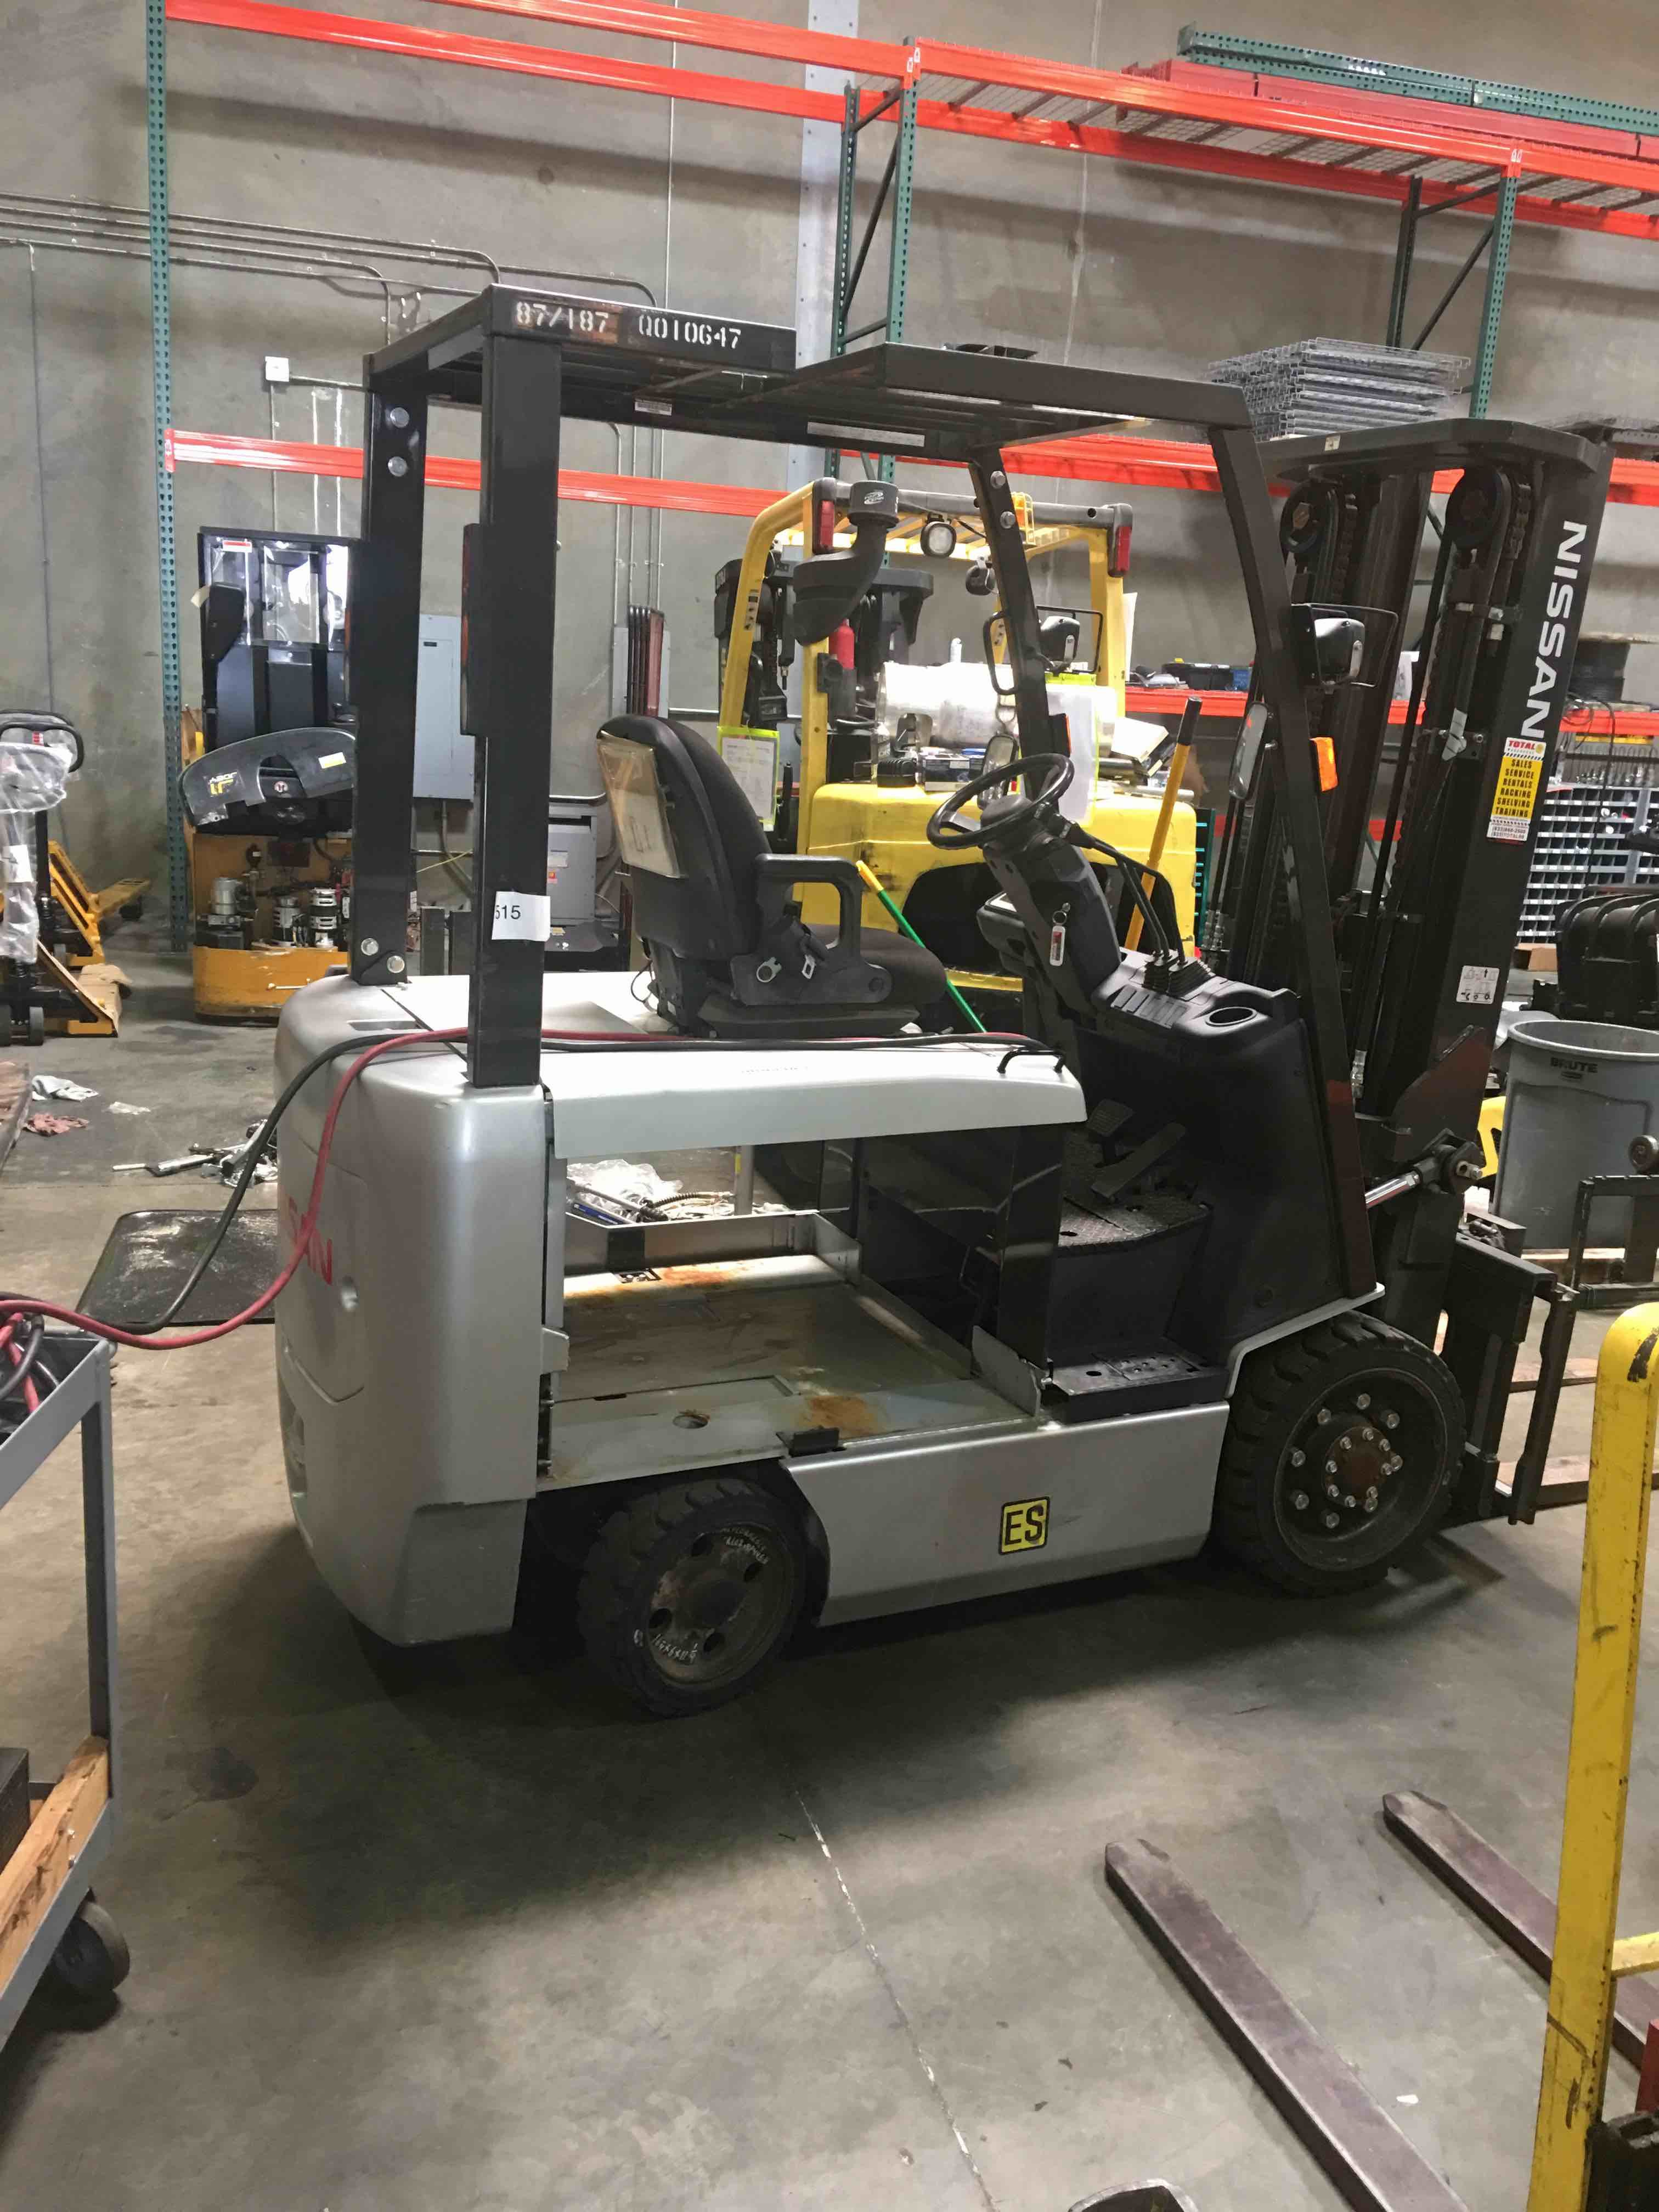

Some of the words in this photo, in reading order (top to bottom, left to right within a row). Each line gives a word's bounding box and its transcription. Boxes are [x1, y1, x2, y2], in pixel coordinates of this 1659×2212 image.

[1521, 521, 1587, 738] NISSAN
[1509, 741, 1536, 750] TOTAL
[1511, 759, 1532, 769] SALES
[1505, 769, 1534, 779] SERVICE
[1503, 778, 1533, 789] RENTALS
[1500, 788, 1531, 799] RACKING
[1497, 797, 1530, 808] SHELVING
[1496, 807, 1528, 817] TRAINING
[1550, 1057, 1598, 1073] BRUTE
[1005, 1504, 1044, 1545] ES
